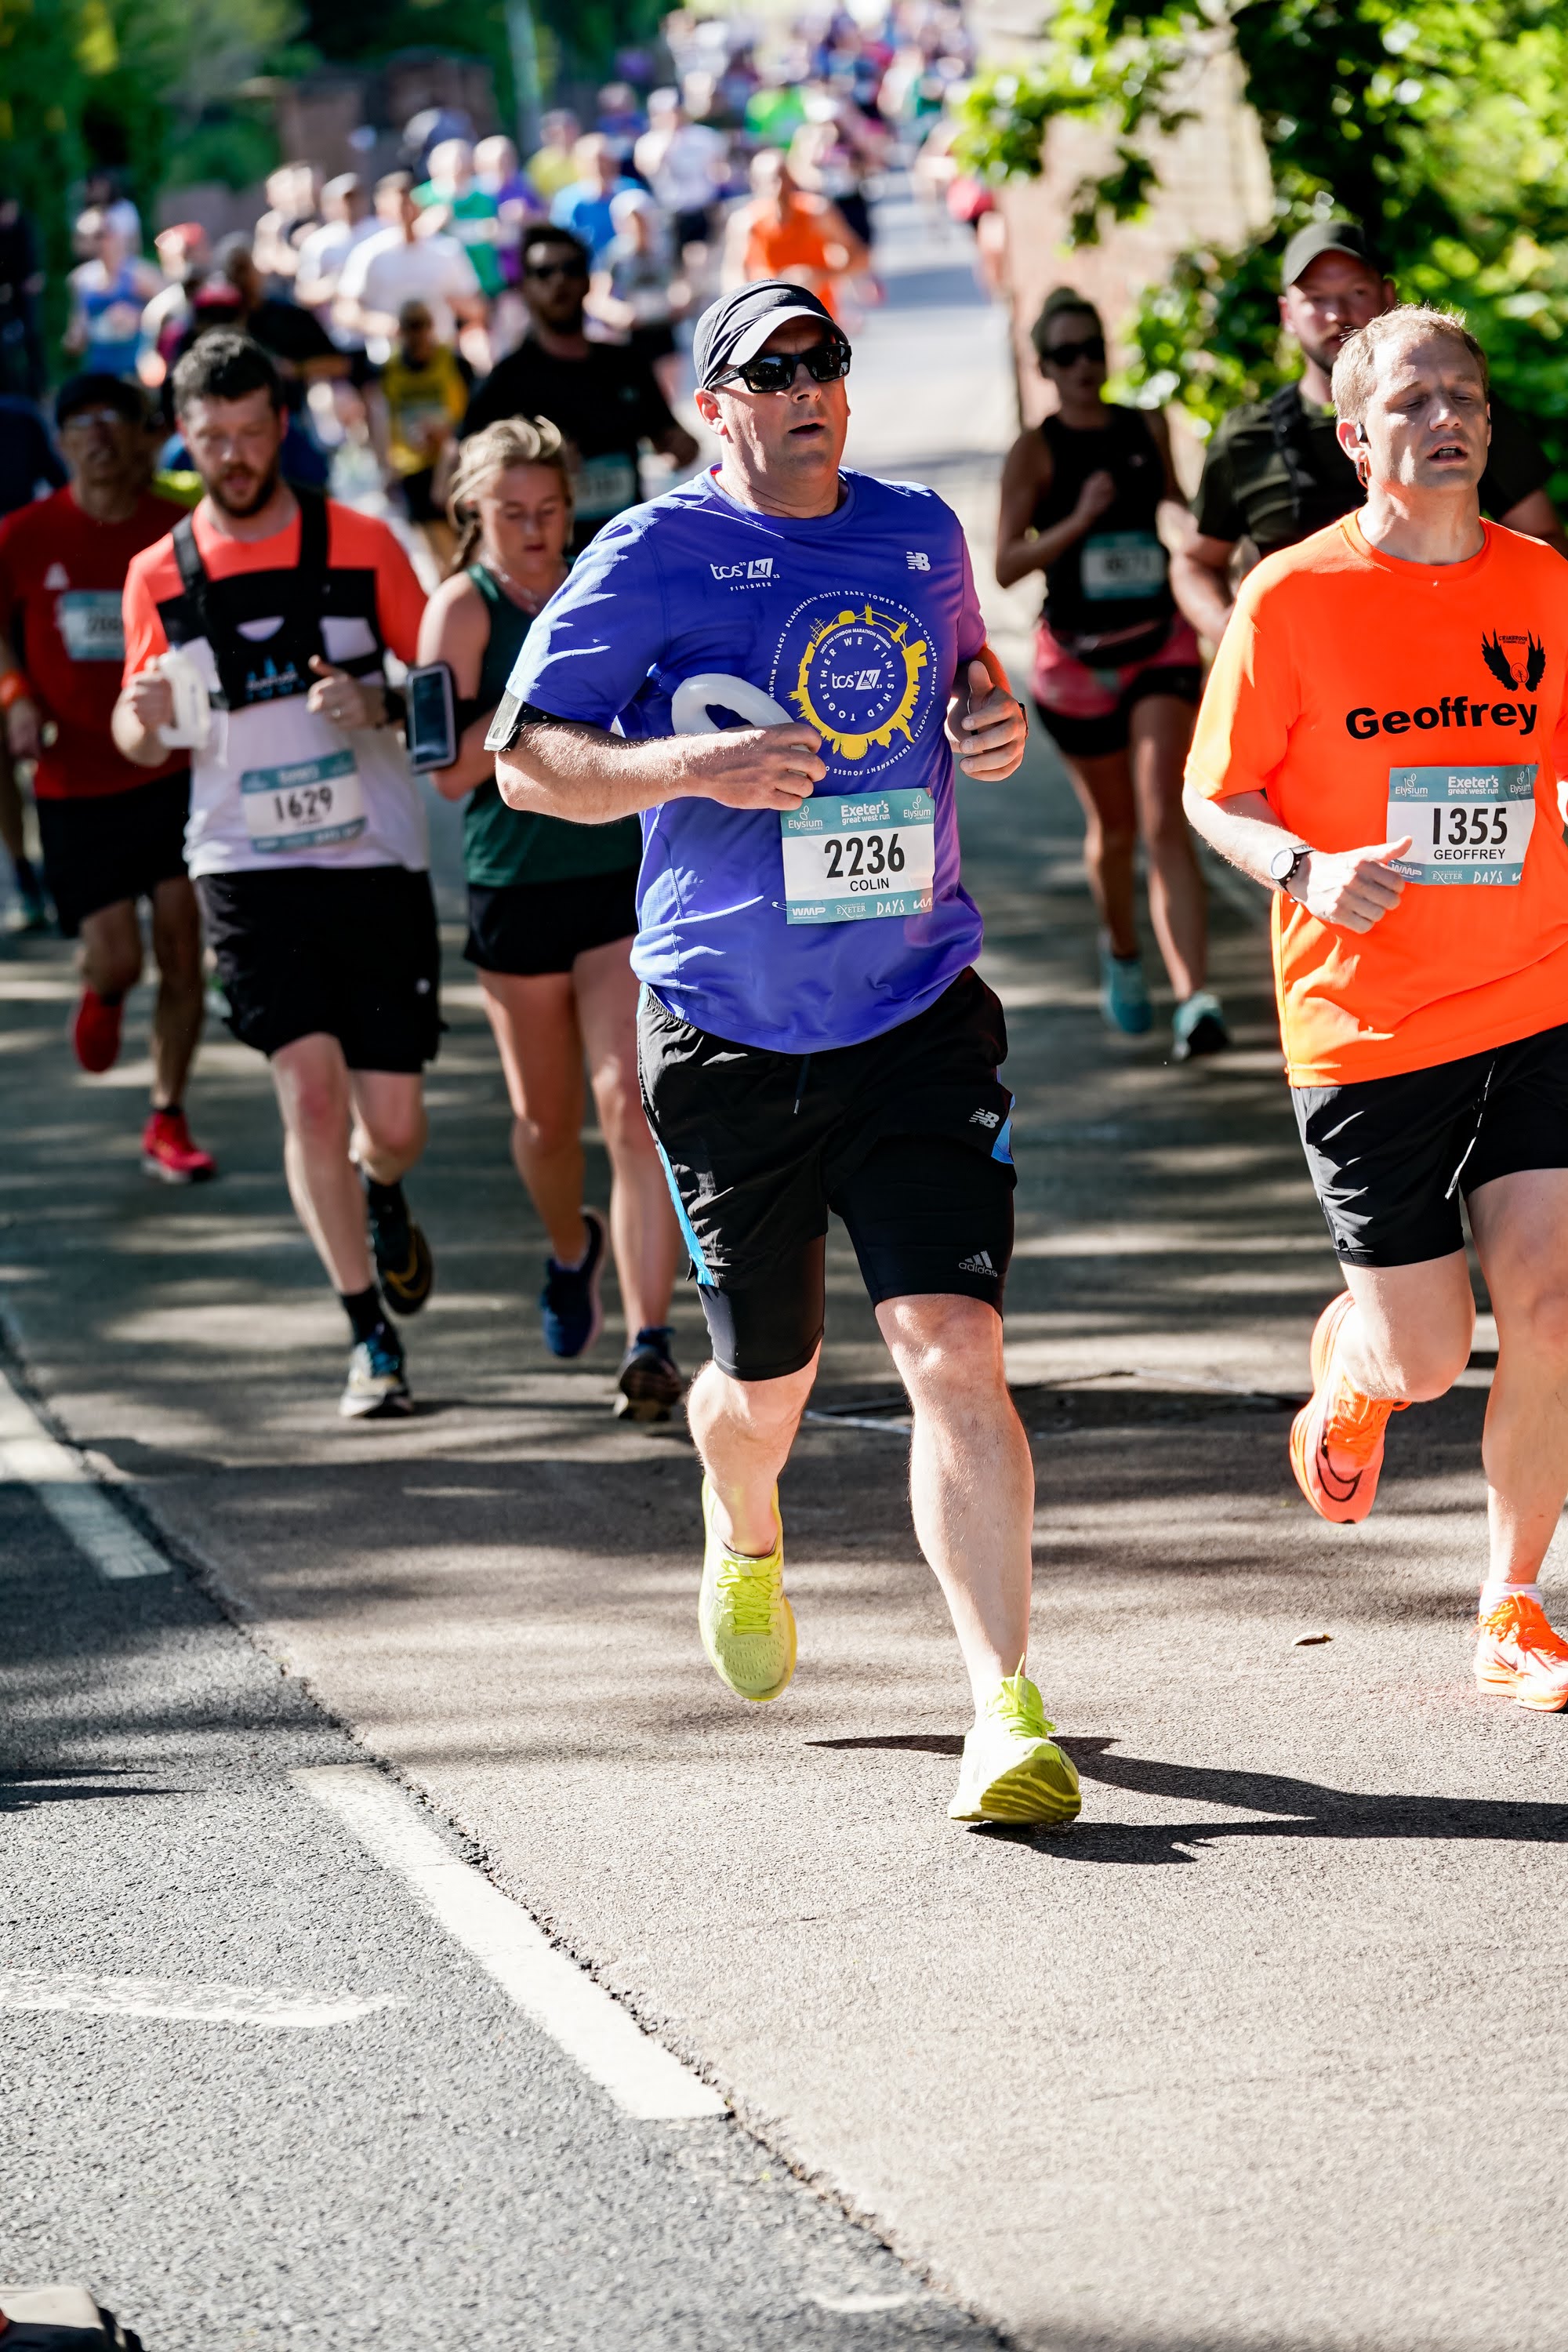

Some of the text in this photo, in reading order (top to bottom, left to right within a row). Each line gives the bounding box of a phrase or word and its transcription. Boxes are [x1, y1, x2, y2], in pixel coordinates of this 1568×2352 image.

[710, 563, 744, 580] tcs
[730, 582, 772, 592] FINISHER
[819, 590, 841, 600] CUTTY
[868, 593, 895, 606] TOWER
[785, 596, 818, 628] BLACKHEATH
[898, 604, 923, 628] BRIDGE
[833, 629, 852, 639] LONDON
[852, 628, 877, 637] MARATHON
[876, 633, 892, 649] FINISHER
[923, 630, 938, 662] CANARY
[773, 632, 787, 665] PALACE
[820, 637, 895, 721] WE FINISHED TOGETHER
[832, 673, 855, 689] tcs
[1345, 695, 1537, 740] Geoffrey
[866, 744, 910, 775] EMBANKMENT
[833, 768, 863, 777] HOUSES
[1447, 775, 1499, 788] Exeter's
[1510, 784, 1531, 794] Elysium
[1395, 786, 1428, 797] Elysium
[840, 800, 890, 818] Exeter's
[903, 808, 931, 820] Elysium
[788, 819, 823, 830] Elysium
[841, 815, 861, 826] great
[861, 814, 879, 823] west
[1433, 807, 1508, 845] 1355
[824, 833, 906, 879] 2236
[1434, 849, 1505, 860] GEOFFREY
[850, 877, 890, 892] COLIN
[1432, 872, 1463, 883] EXETER
[1473, 870, 1503, 884] DAYS
[792, 906, 826, 916] WMP
[835, 904, 867, 917] EXETER
[876, 898, 906, 916] DAYS
[958, 1261, 998, 1278] adidas
